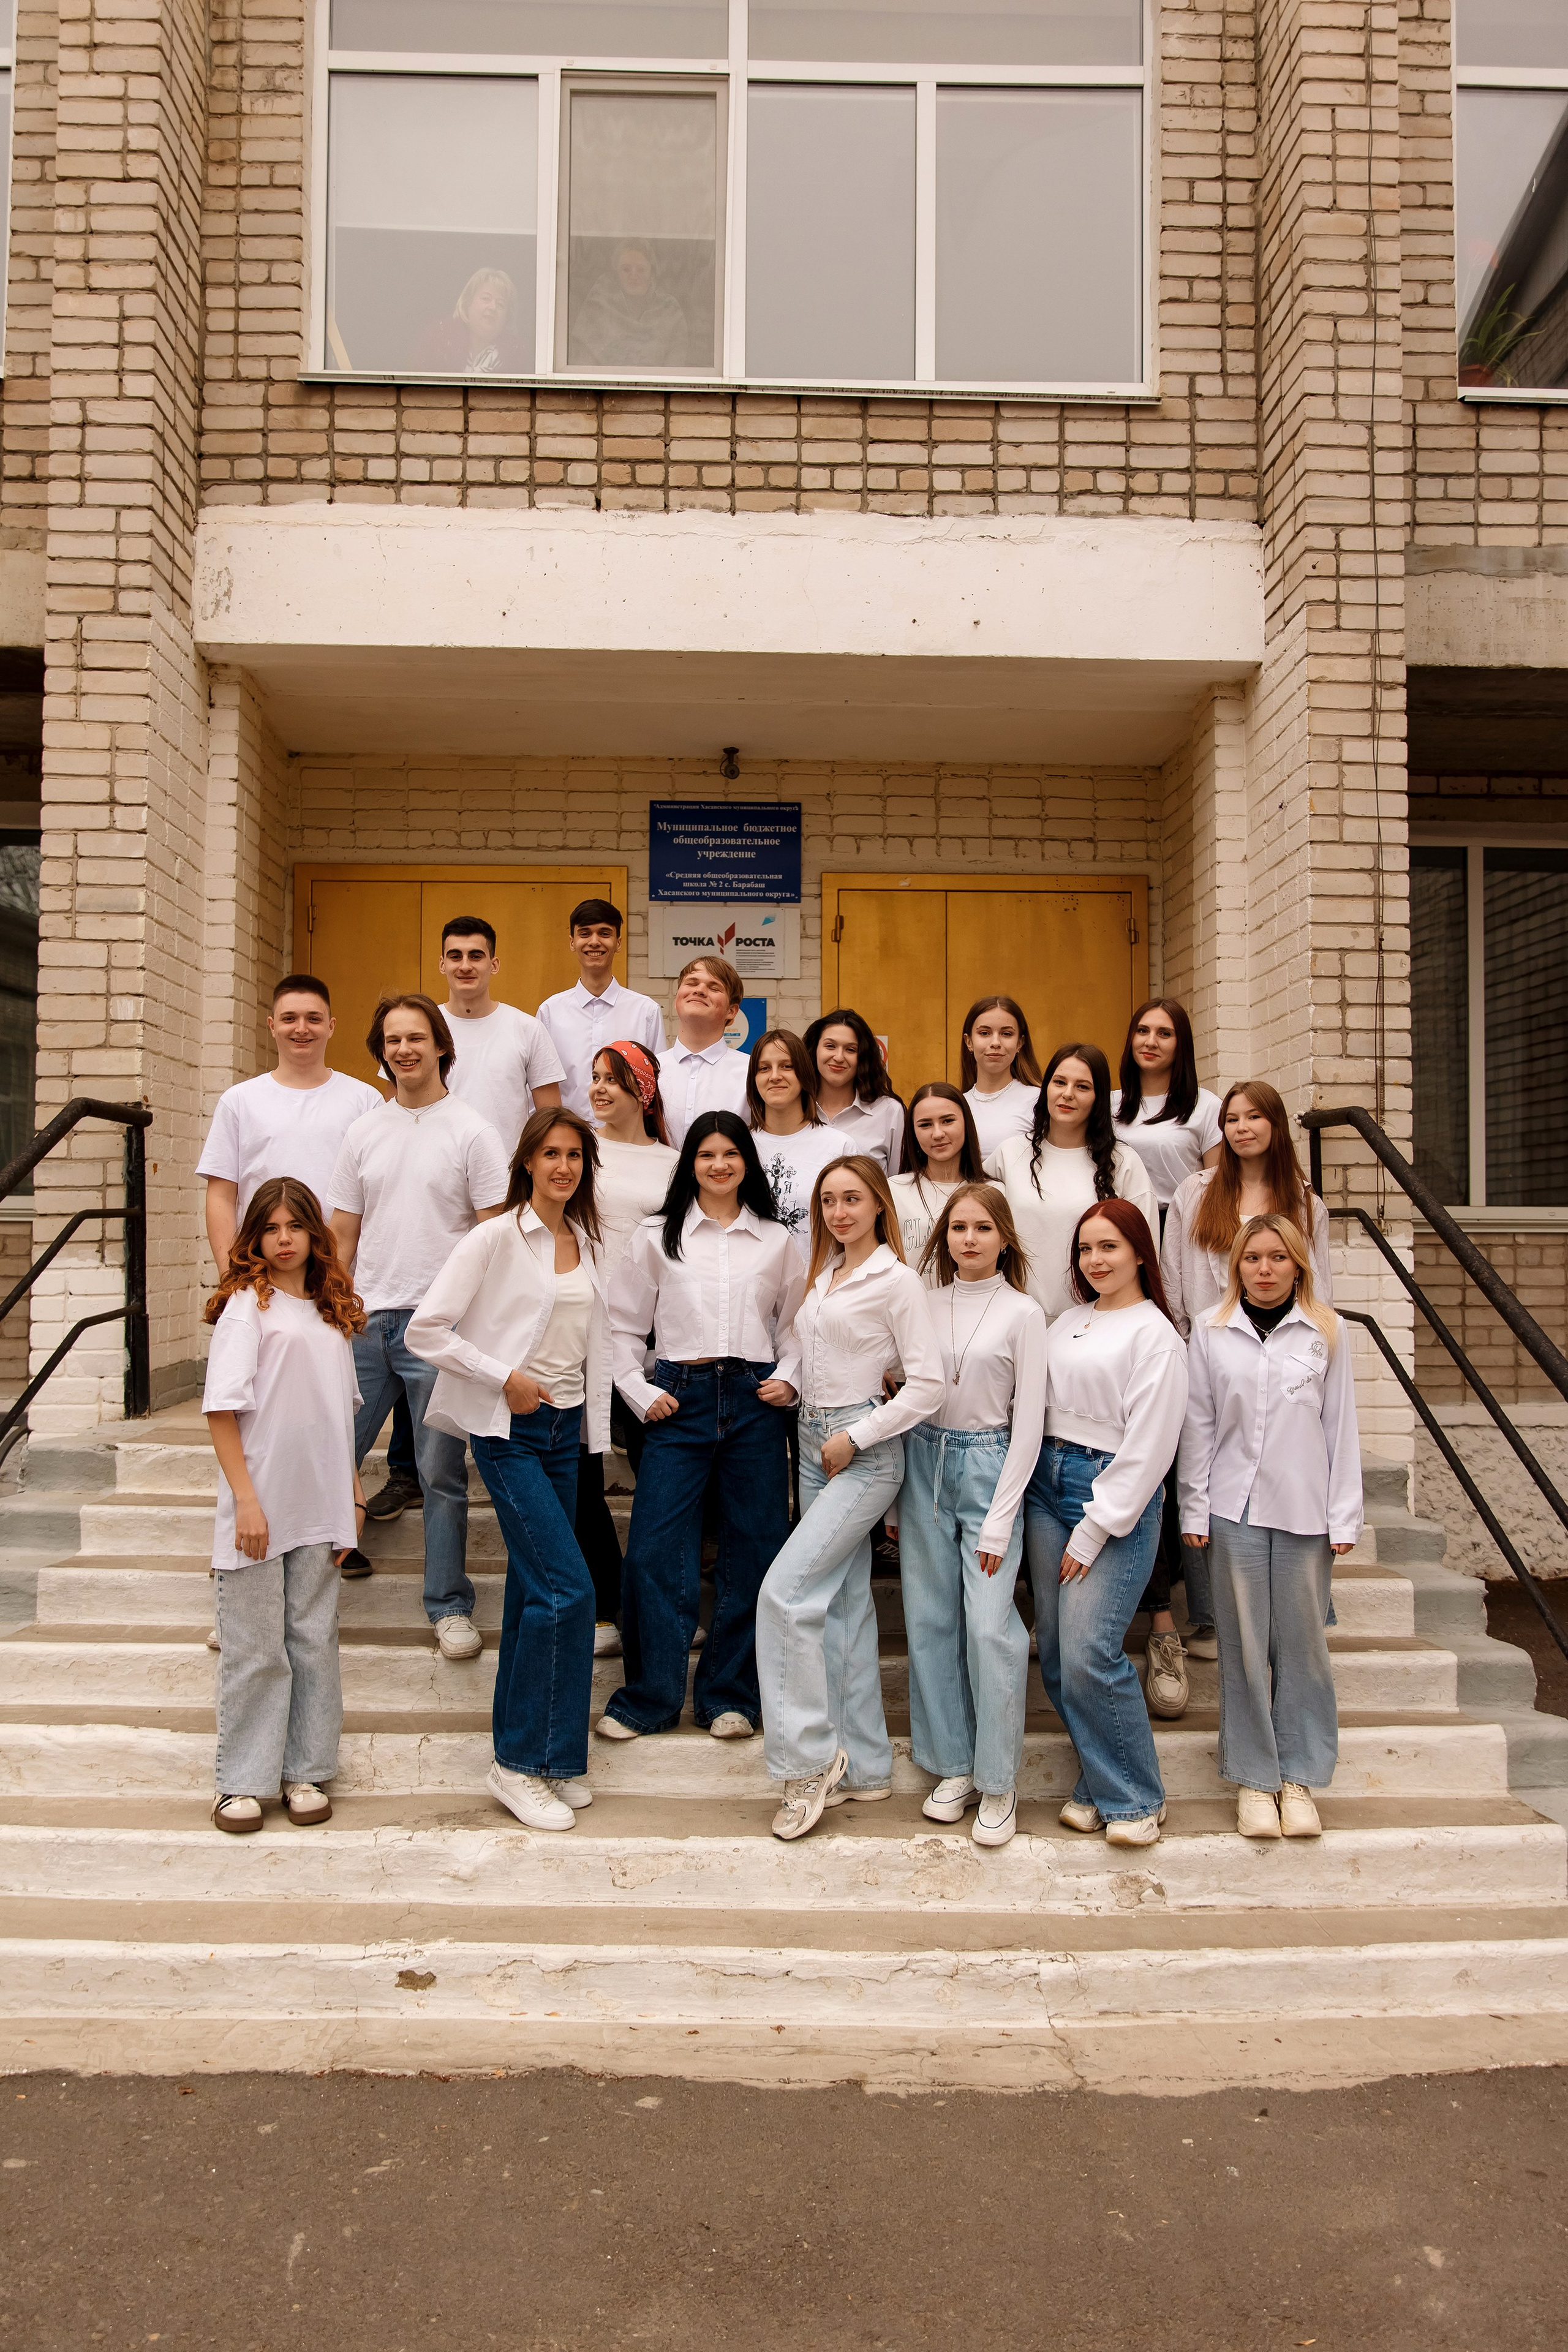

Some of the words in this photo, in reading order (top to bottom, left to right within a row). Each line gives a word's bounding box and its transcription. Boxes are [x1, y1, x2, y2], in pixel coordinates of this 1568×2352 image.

[657, 821, 739, 833] Муниципальное
[744, 823, 797, 832] бюджетное
[673, 835, 781, 846] общеобразовательное
[697, 850, 756, 860] учреждение
[665, 871, 701, 880] «Средняя
[703, 872, 783, 880] общеобразовательная
[672, 937, 715, 946] ТОЧКА
[736, 937, 775, 947] РОСТА
